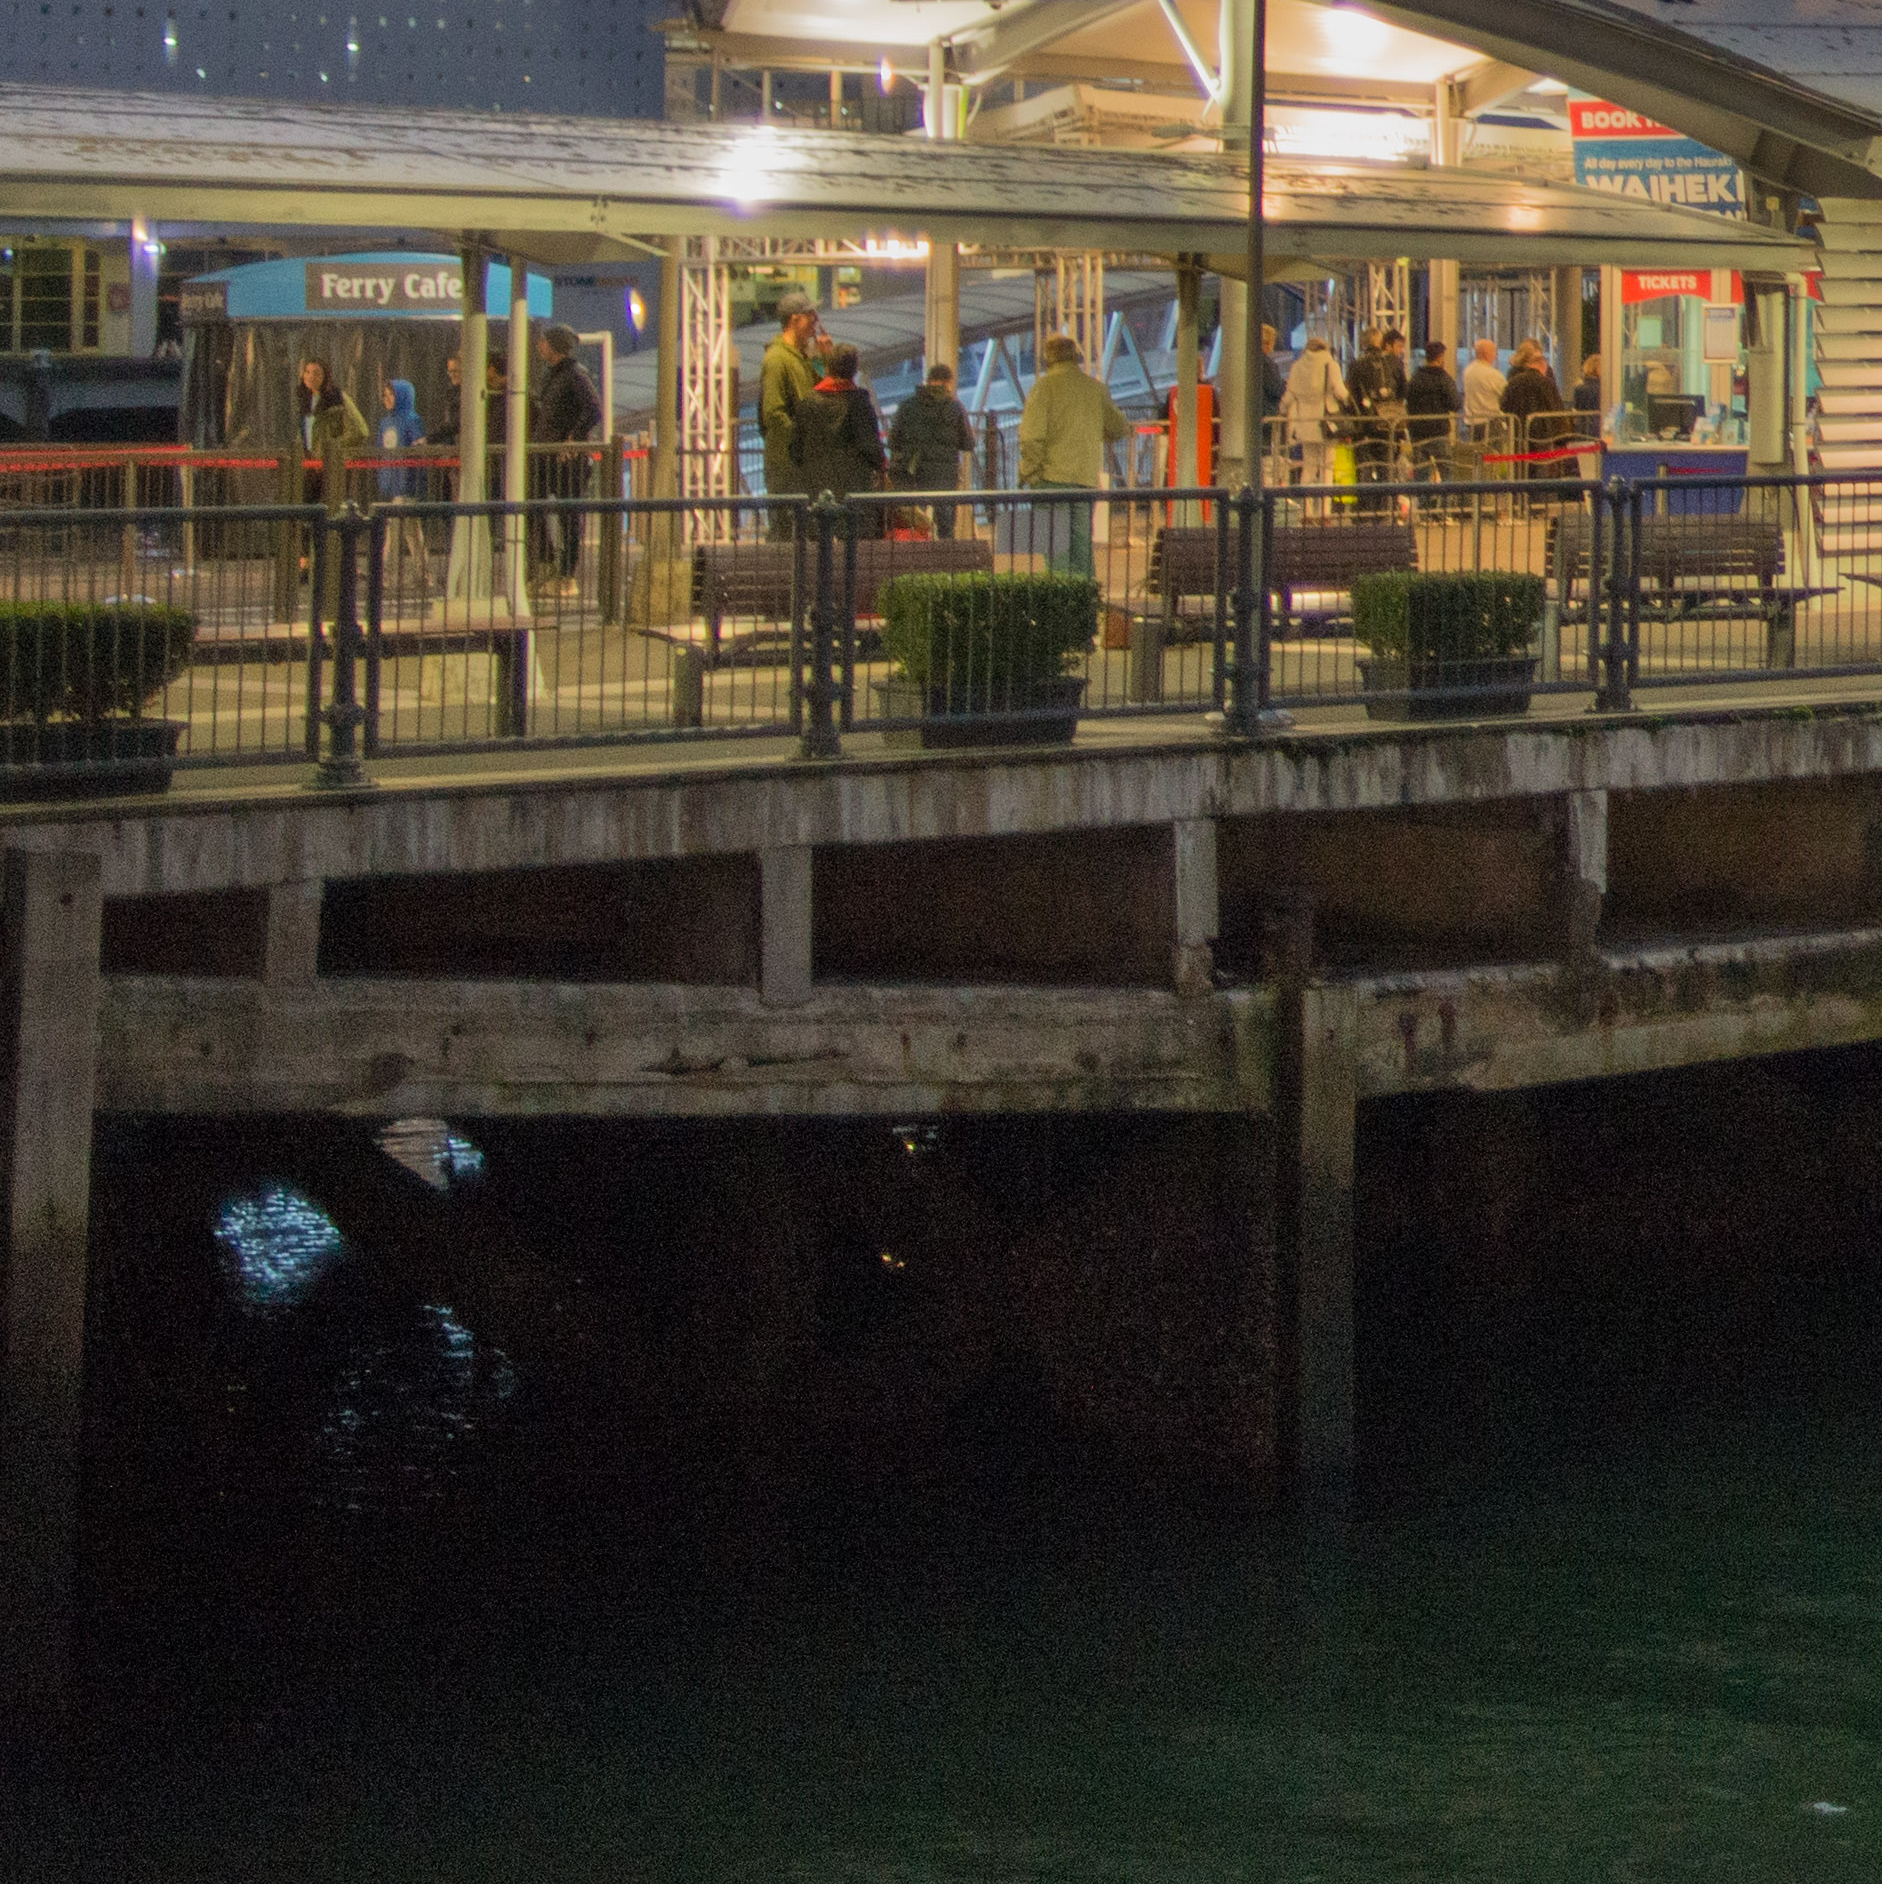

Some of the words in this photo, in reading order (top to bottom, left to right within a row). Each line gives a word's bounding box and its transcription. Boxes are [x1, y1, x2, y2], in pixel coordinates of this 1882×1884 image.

[1581, 110, 1641, 129] BOOK
[322, 273, 396, 305] Ferry
[403, 271, 463, 299] Cafe
[1638, 275, 1698, 290] TICKETS
